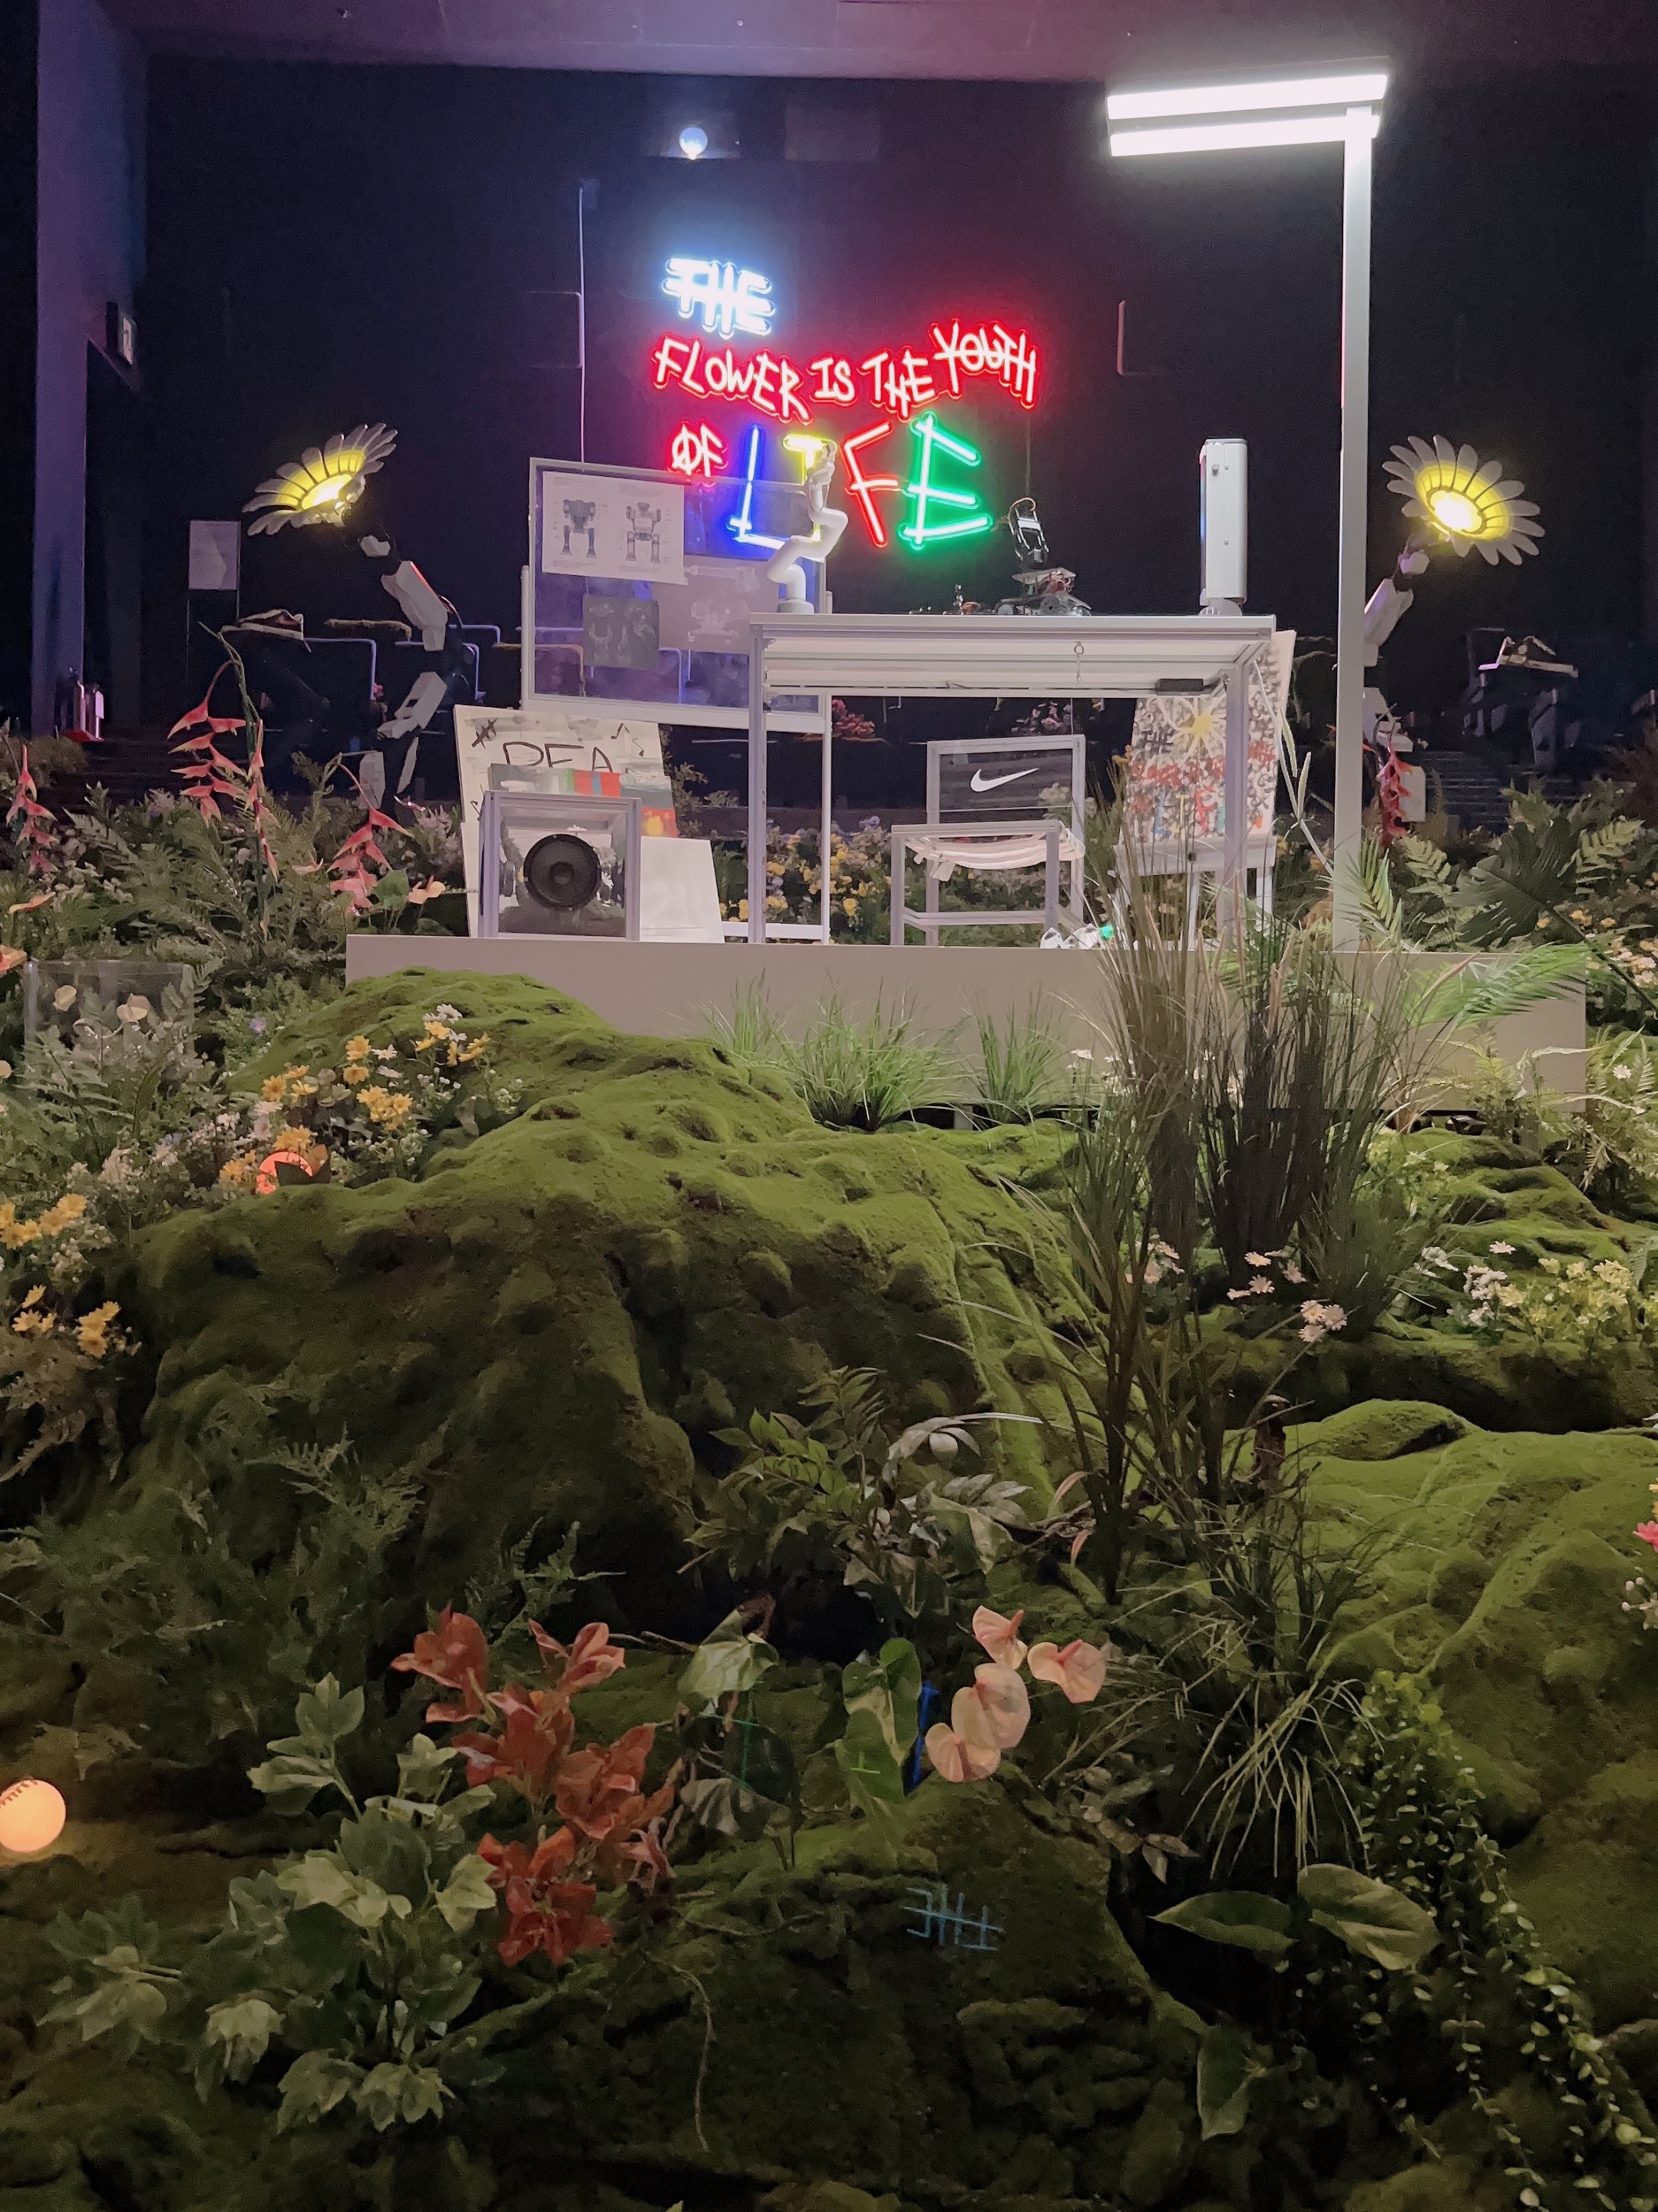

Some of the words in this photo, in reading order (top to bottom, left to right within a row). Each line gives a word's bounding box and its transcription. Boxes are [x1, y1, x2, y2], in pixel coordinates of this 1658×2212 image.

[663, 258, 774, 336] THE
[652, 336, 811, 422] FLOWER
[810, 355, 856, 405] IS
[858, 346, 936, 422] THE
[933, 319, 1038, 408] YOUTH
